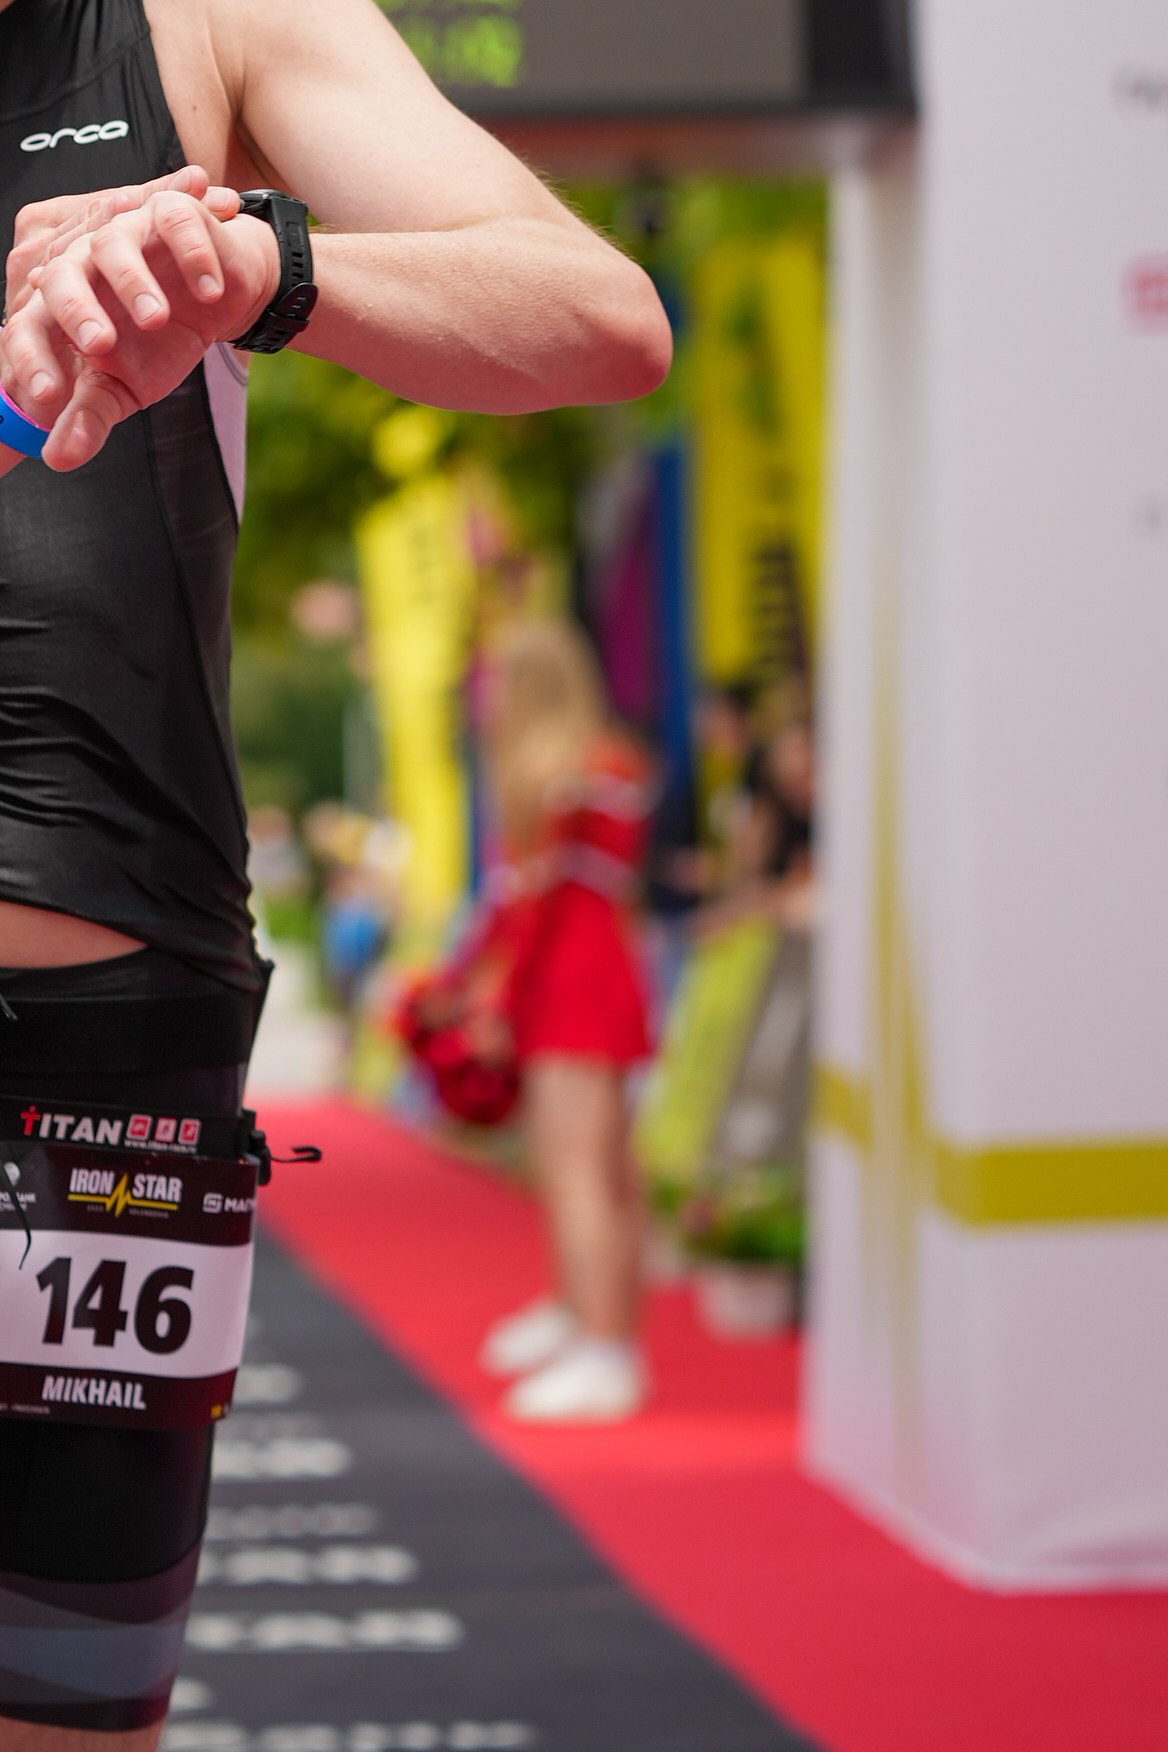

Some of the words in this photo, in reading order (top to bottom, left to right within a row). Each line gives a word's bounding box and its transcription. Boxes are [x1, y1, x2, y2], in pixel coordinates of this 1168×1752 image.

[19, 119, 130, 152] orca
[20, 1105, 123, 1146] TITAN
[69, 1167, 115, 1195] IRON
[132, 1173, 183, 1203] STAR
[36, 1256, 195, 1355] 146
[41, 1375, 147, 1410] MIKHAIL
